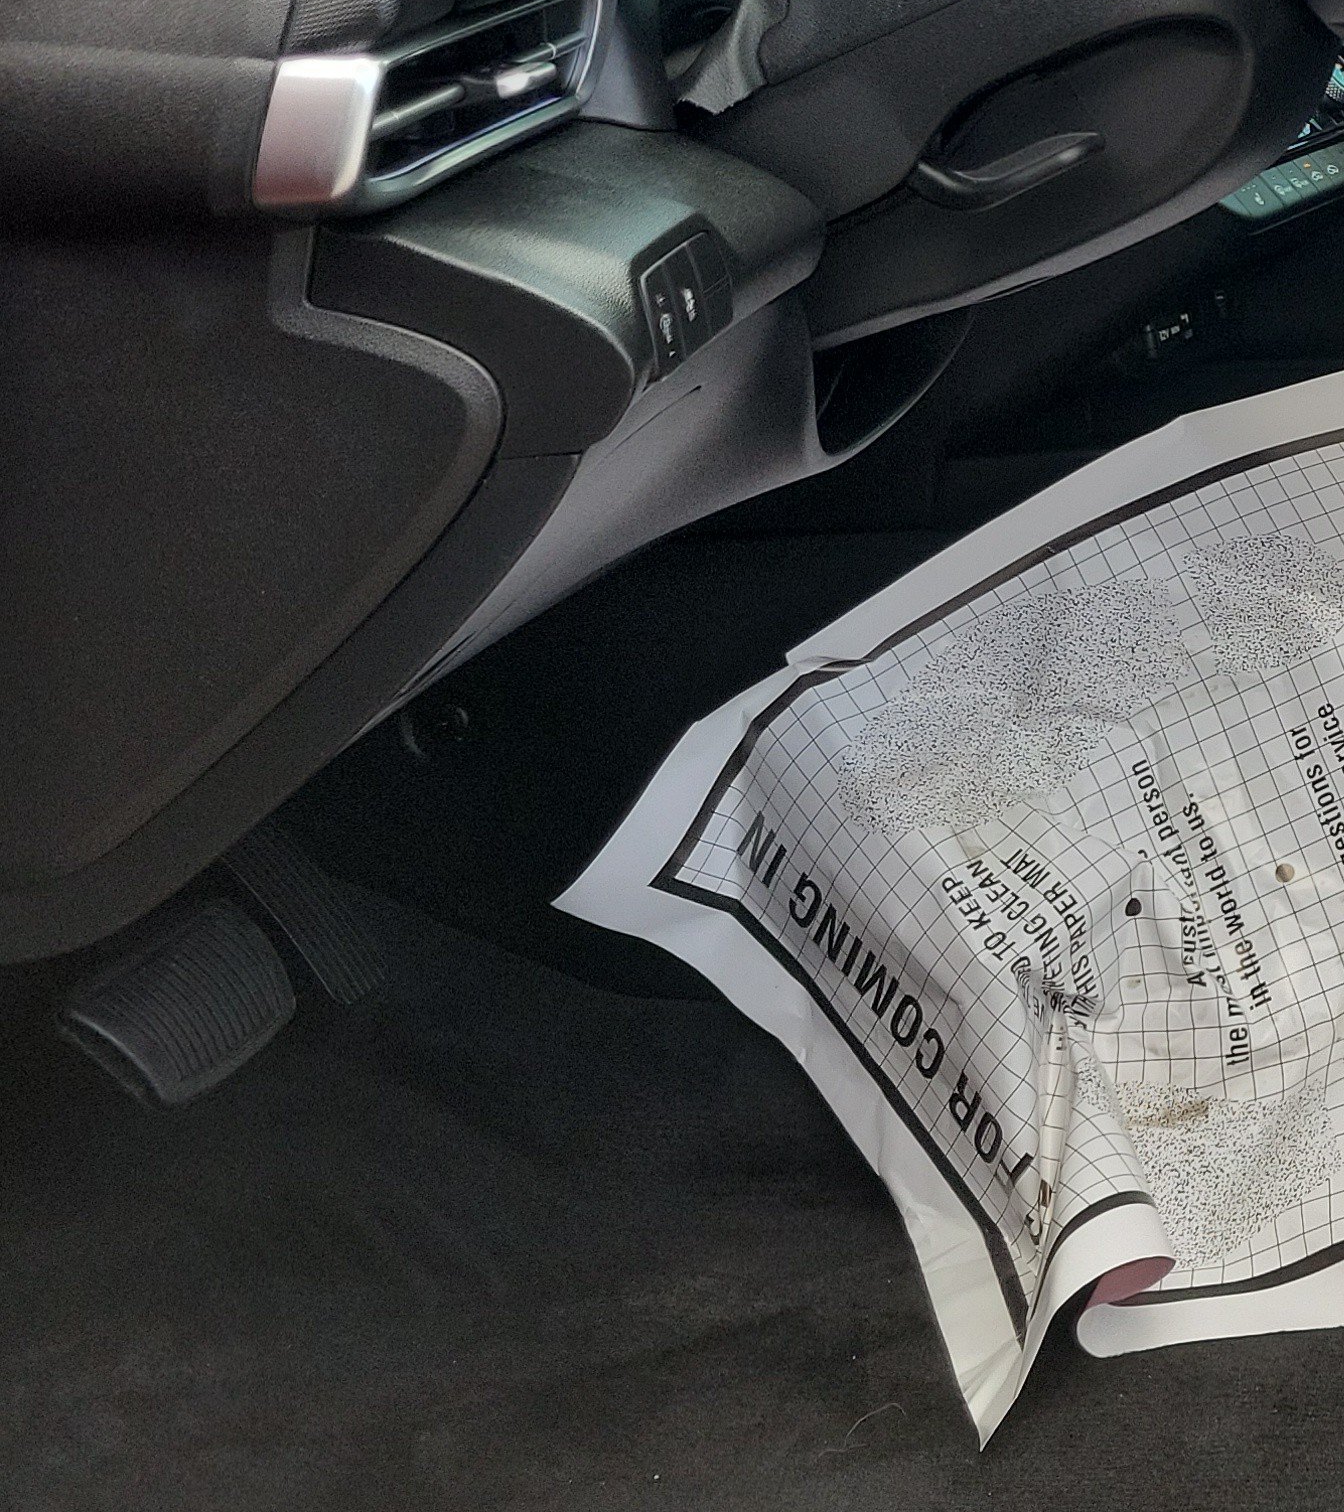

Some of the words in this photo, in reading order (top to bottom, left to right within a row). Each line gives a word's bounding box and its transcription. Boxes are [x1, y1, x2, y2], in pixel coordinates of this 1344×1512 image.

[1290, 726, 1315, 761] for
[1130, 758, 1180, 842] person
[1181, 792, 1205, 833] us.
[737, 811, 787, 888] IN
[1000, 848, 1050, 889] MAT
[1198, 835, 1218, 863] to
[941, 876, 991, 930] KEEP
[966, 859, 1030, 921] CLEAN
[1205, 864, 1244, 936] world
[1043, 881, 1087, 956] PAPER
[984, 931, 1016, 962] TO
[1234, 939, 1266, 982] the
[789, 871, 945, 1079] COMING
[1186, 969, 1207, 988] A
[1249, 980, 1272, 1010] in
[1224, 1026, 1249, 1066] the
